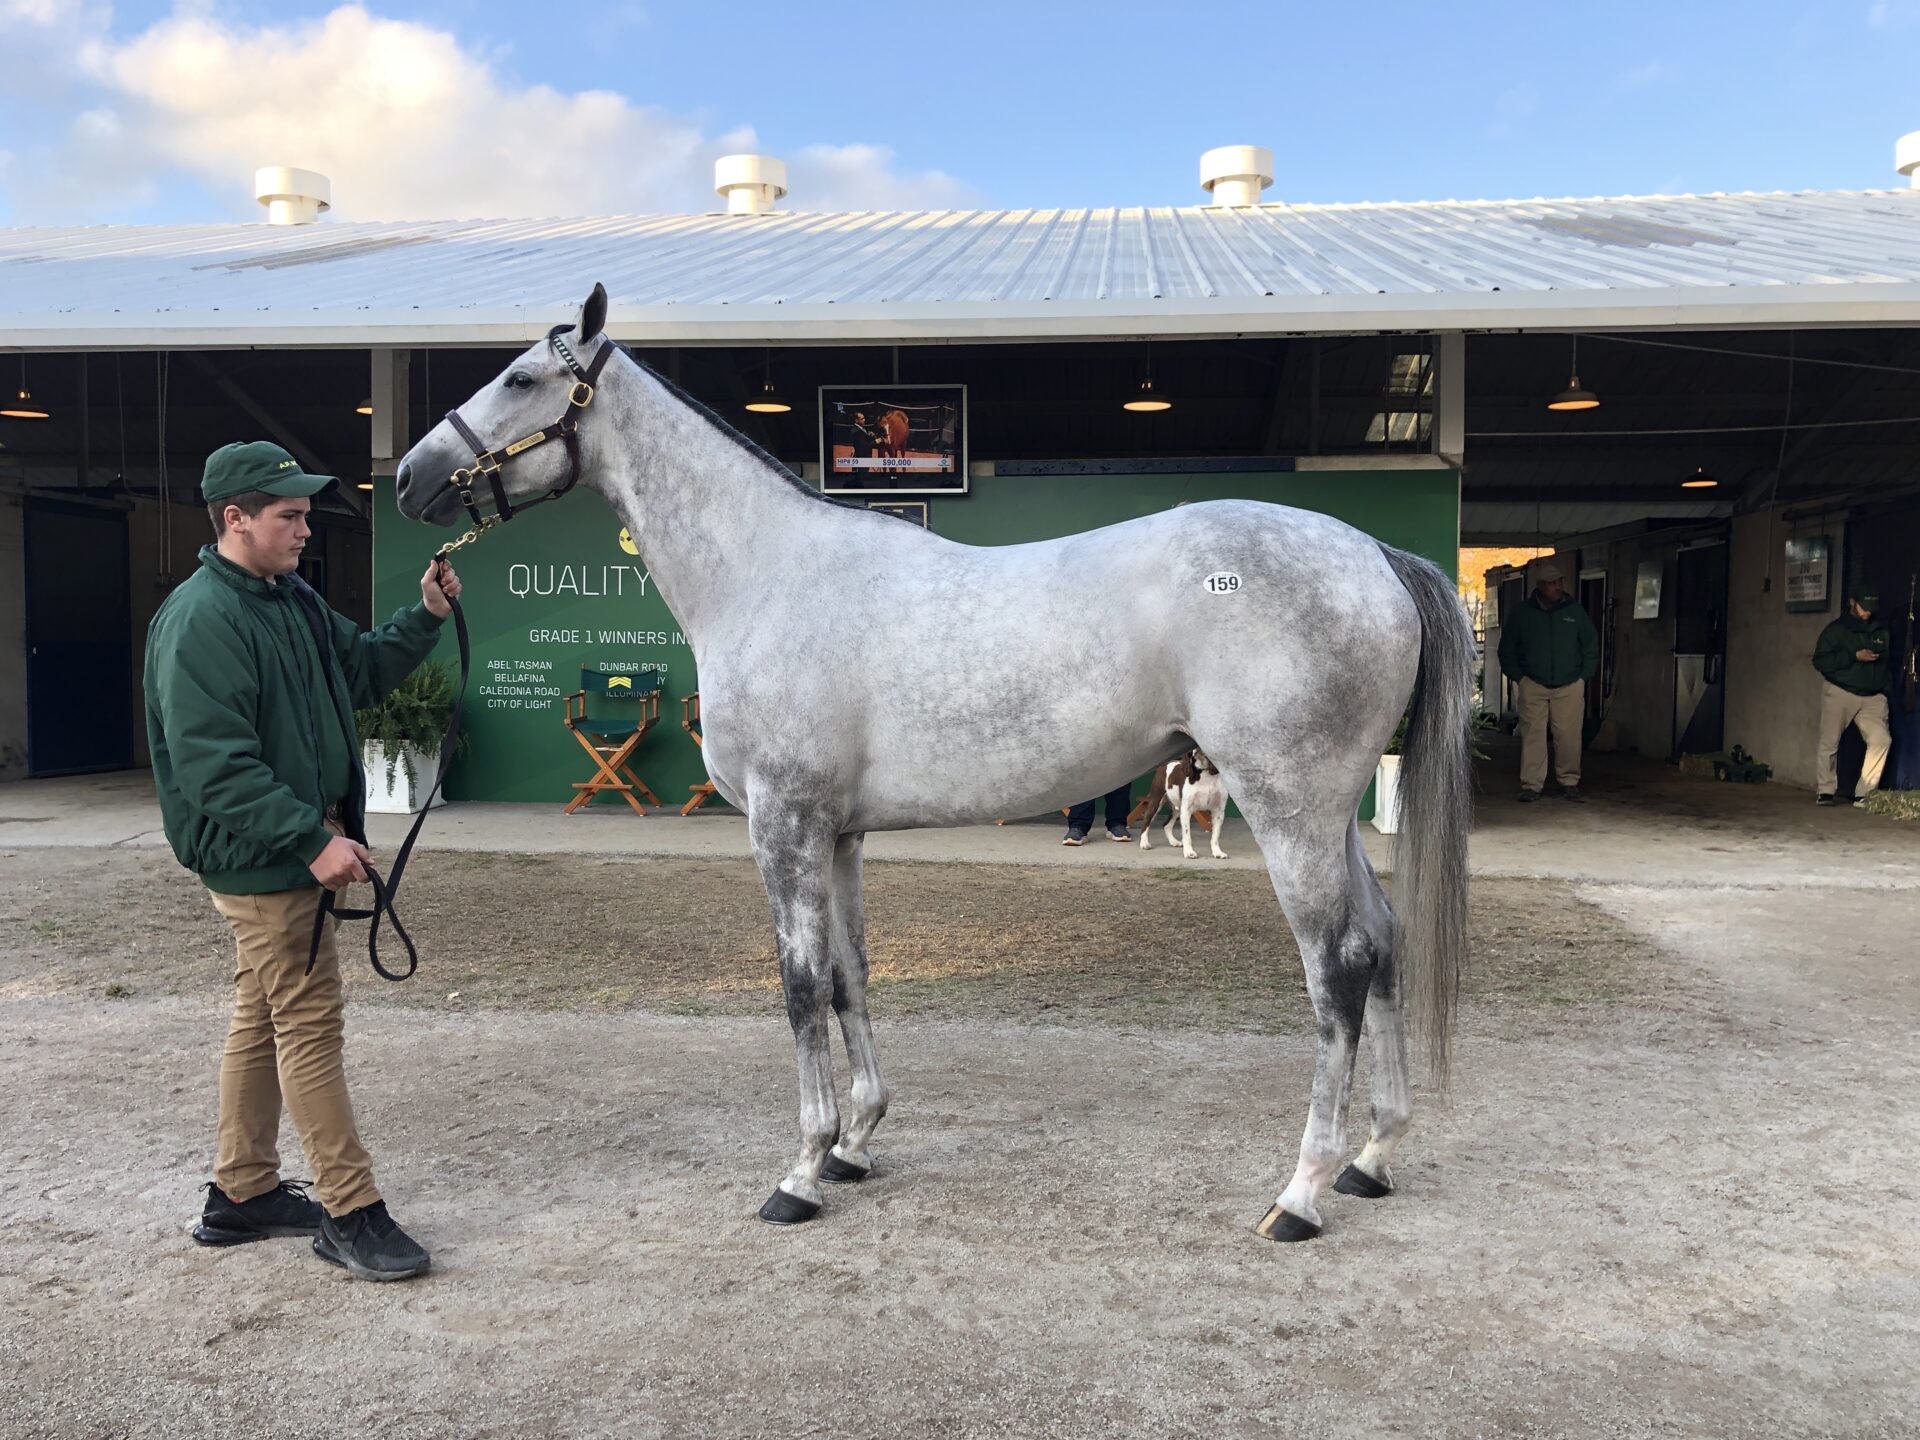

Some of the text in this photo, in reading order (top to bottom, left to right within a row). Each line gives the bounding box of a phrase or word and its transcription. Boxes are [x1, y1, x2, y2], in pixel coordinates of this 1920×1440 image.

[509, 563, 650, 599] QUALITY
[1208, 576, 1239, 592] 159
[529, 629, 689, 646] GRADE 1 WINNERS IN
[487, 660, 553, 670] ABEL TASMAN
[599, 661, 668, 673] DUNBAR ROAD
[494, 673, 546, 683] BELLAFINA
[479, 686, 561, 696] CALEDONIA ROAD
[606, 690, 662, 698] ILLUMINAT
[487, 699, 553, 709] CITY OF LIGHT
